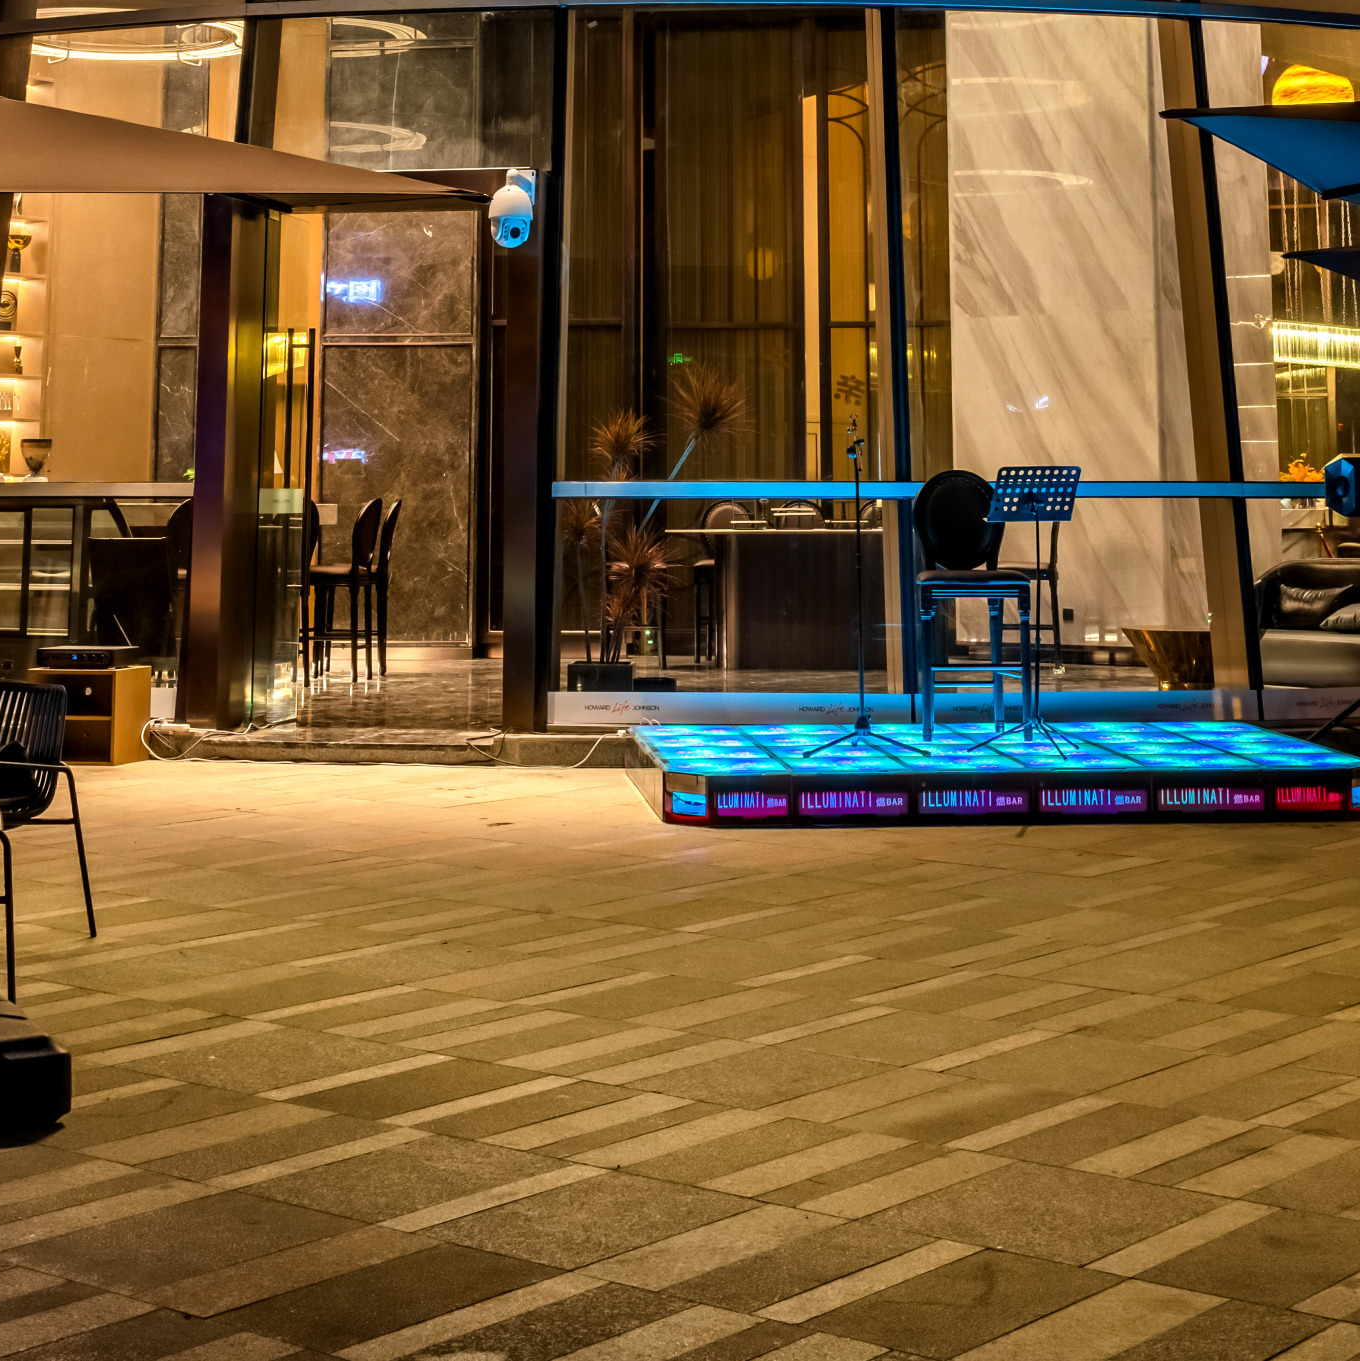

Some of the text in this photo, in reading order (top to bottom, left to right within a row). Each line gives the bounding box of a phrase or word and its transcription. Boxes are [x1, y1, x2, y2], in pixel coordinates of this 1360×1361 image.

[611, 700, 630, 715] Life
[801, 791, 872, 809] ILLUMINATI
[922, 790, 992, 807] ILLUMINATI
[1042, 789, 1111, 806] ILLUMINATI
[1161, 788, 1230, 805] ILLUMINATI
